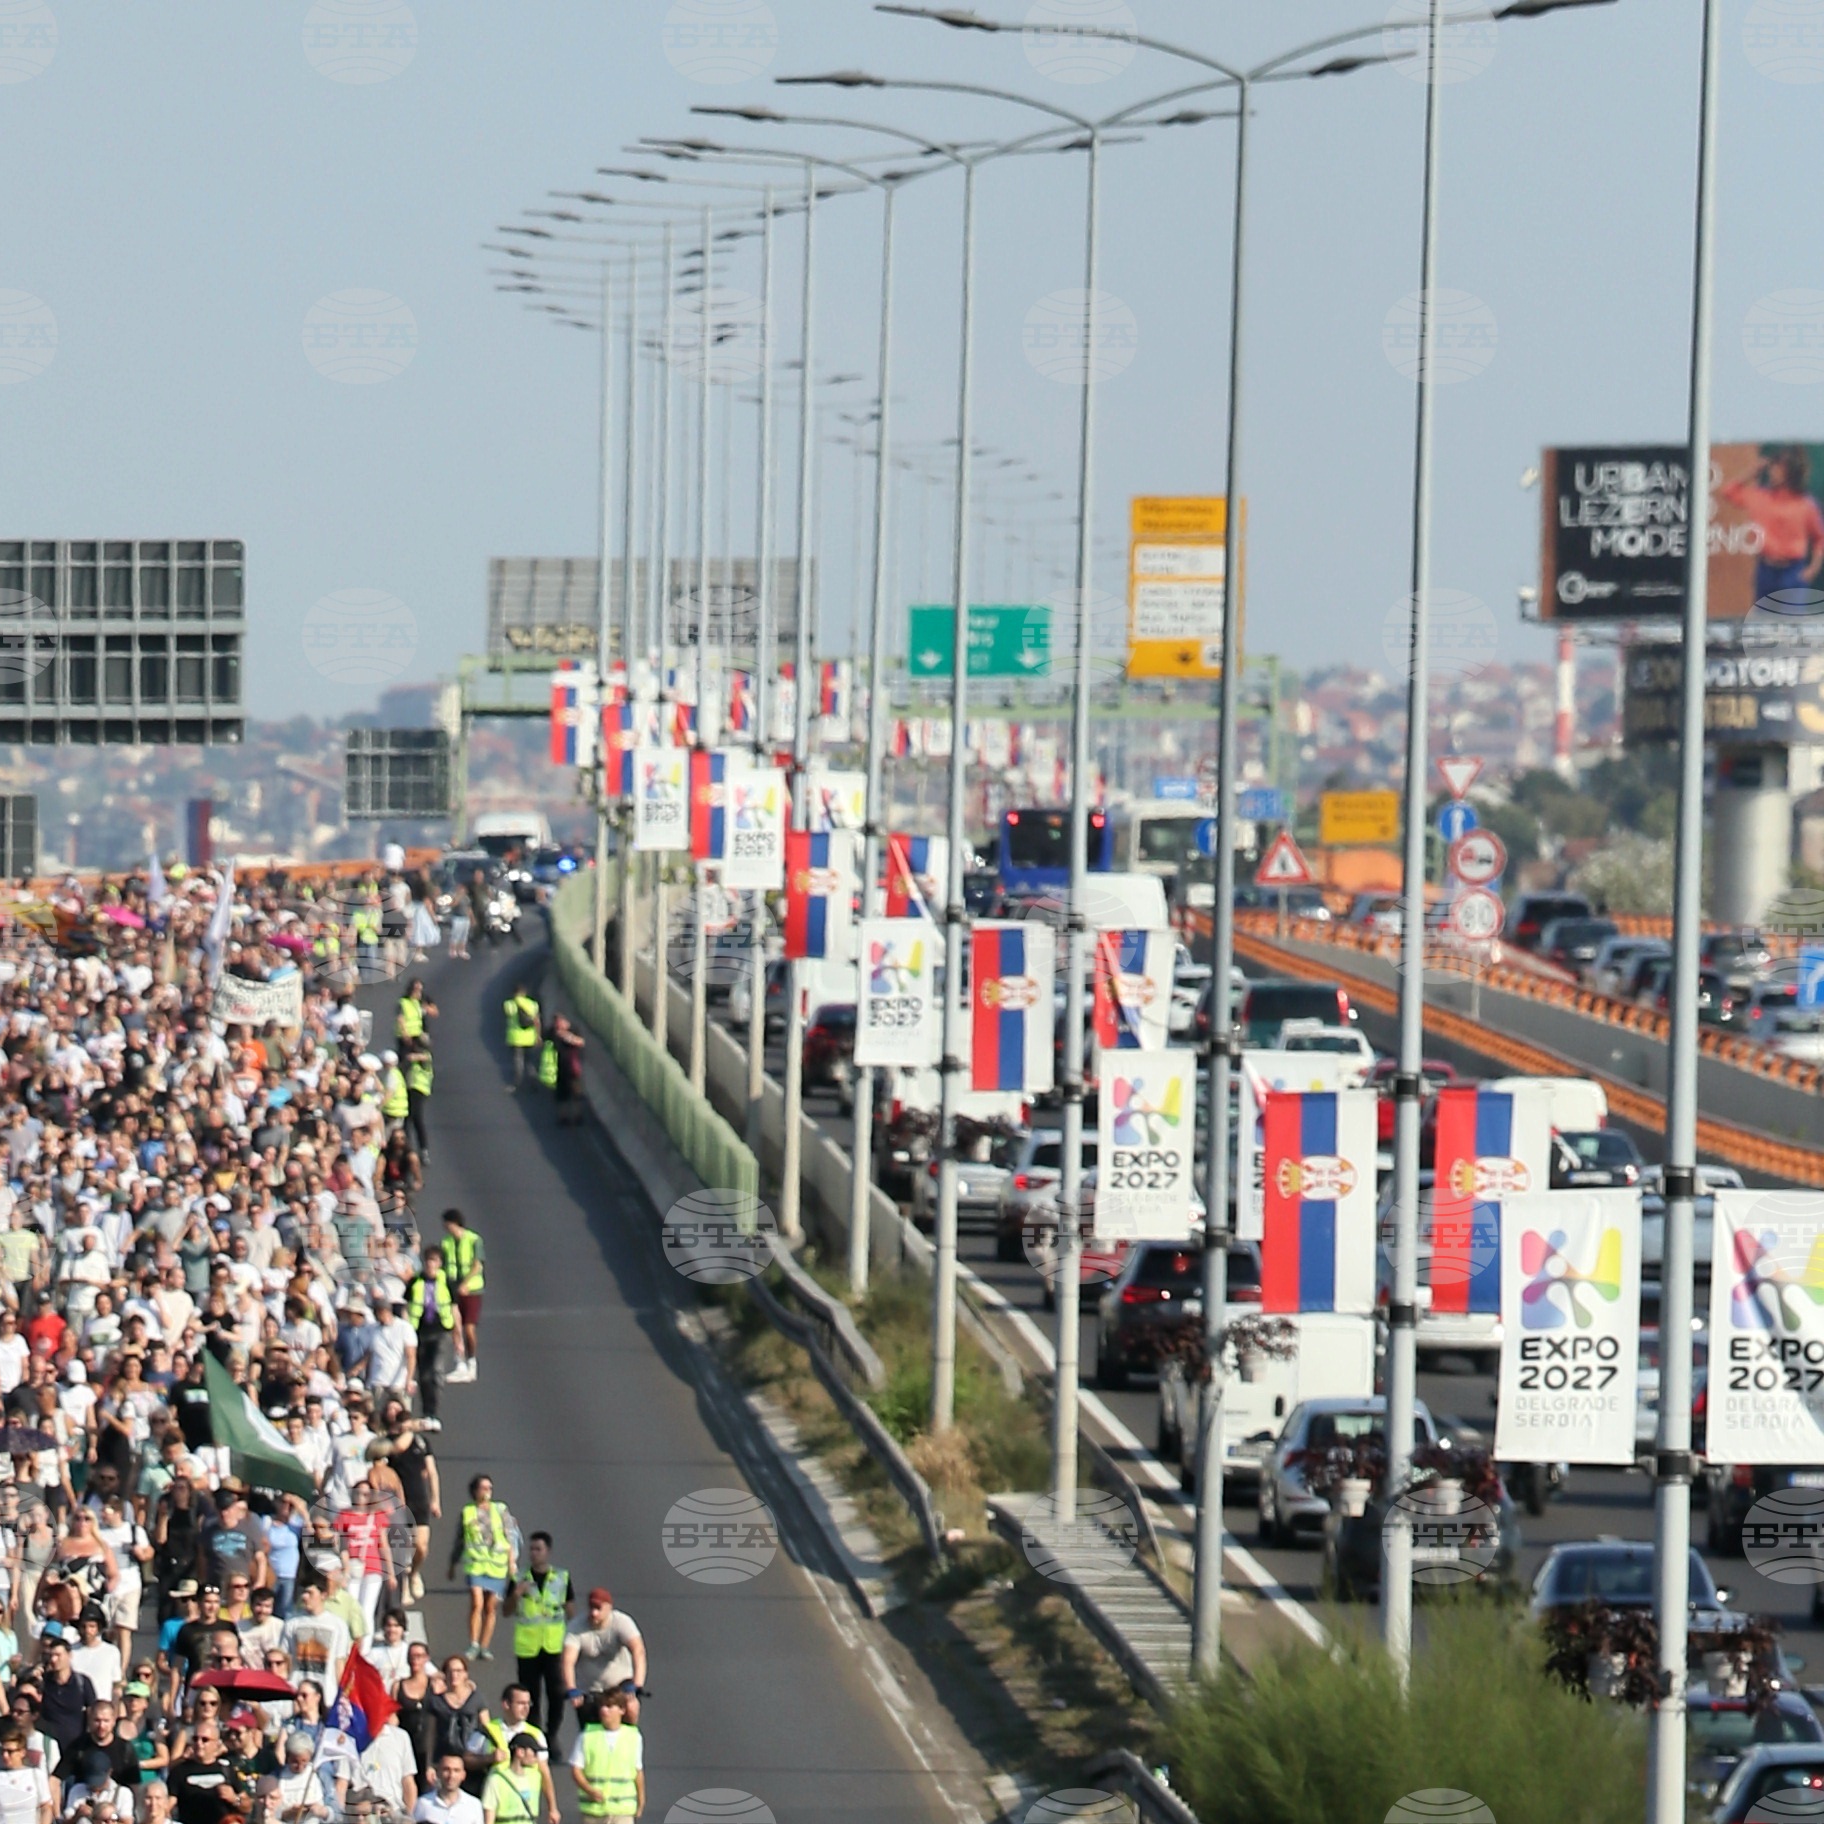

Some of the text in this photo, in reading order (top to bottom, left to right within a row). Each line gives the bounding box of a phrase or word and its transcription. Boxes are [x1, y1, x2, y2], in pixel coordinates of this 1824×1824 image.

[869, 996, 922, 1012] EXPO
[868, 1012, 922, 1027] 2027
[1113, 1152, 1180, 1168] EXPO
[1111, 1172, 1179, 1189] 2027
[1520, 1337, 1620, 1361] EXPO
[1730, 1337, 1824, 1362] EXPO
[1519, 1366, 1620, 1390] 2027
[1729, 1367, 1824, 1392] 2027
[1516, 1396, 1619, 1412] BELGRADE
